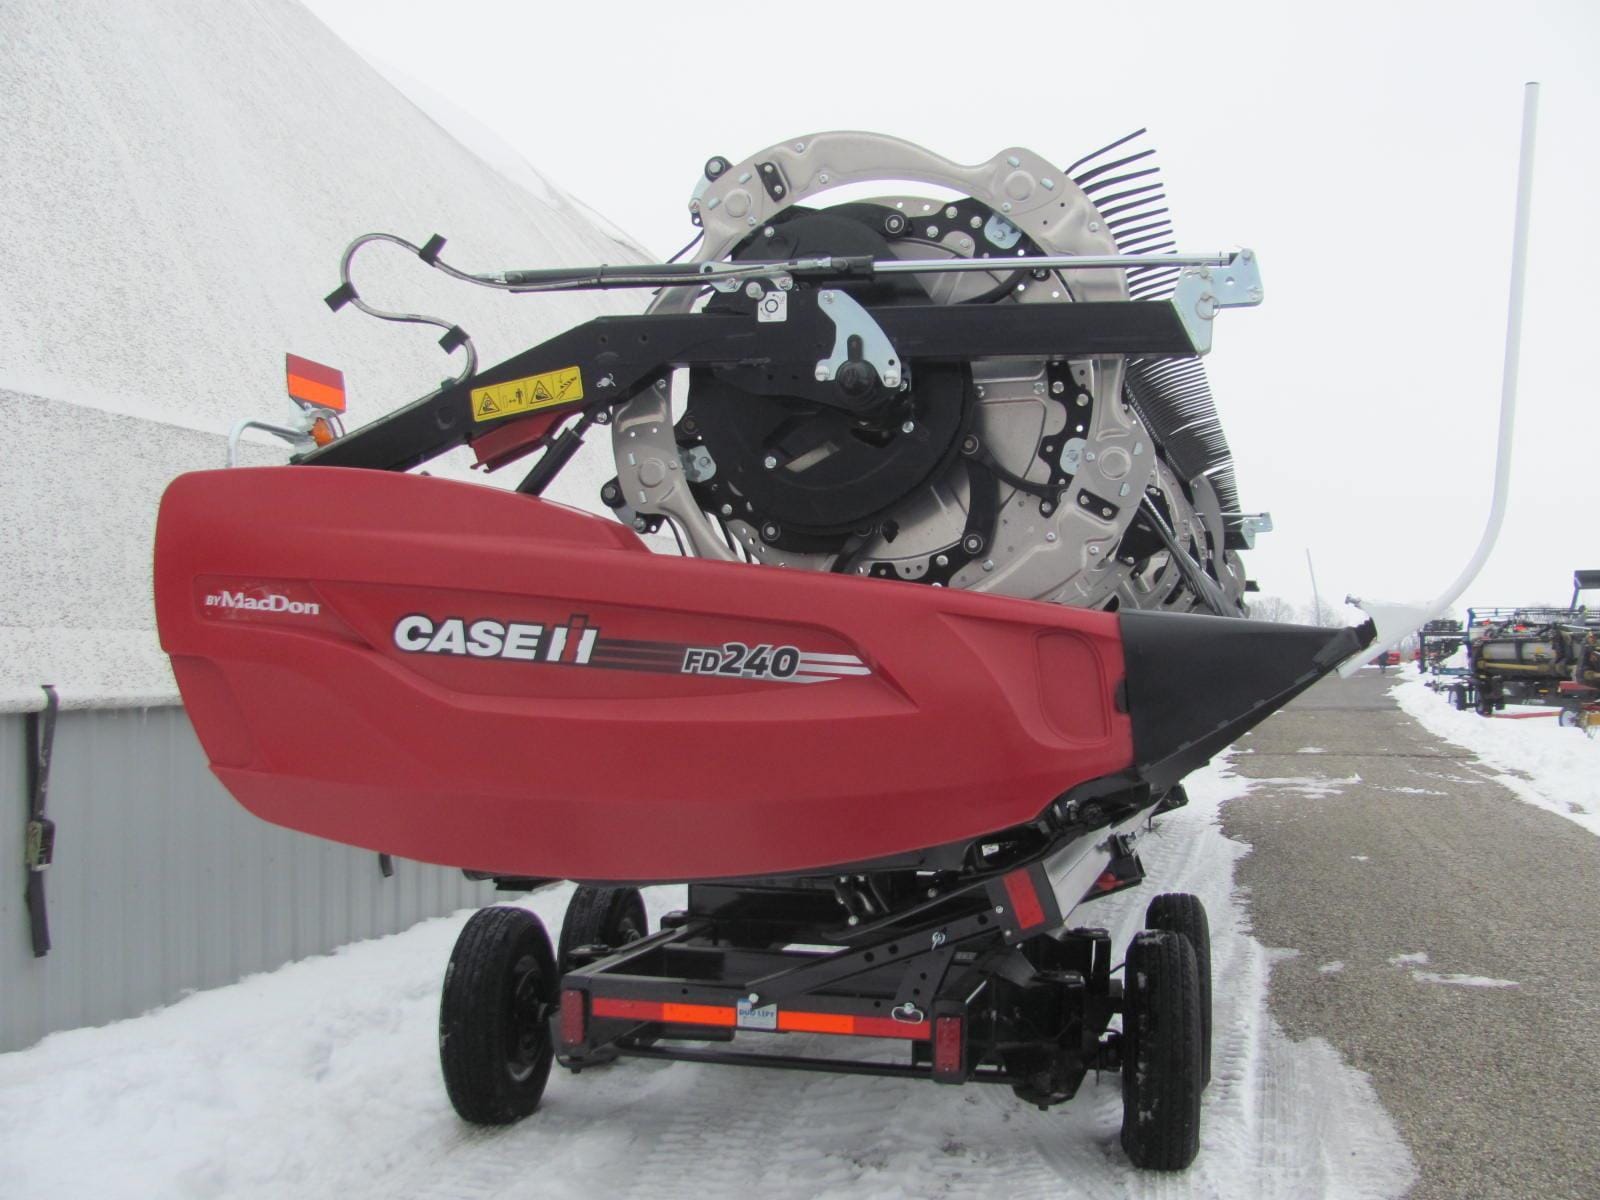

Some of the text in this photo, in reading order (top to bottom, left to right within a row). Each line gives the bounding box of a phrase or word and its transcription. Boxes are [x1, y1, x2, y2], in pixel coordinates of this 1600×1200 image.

[221, 591, 320, 615] MacDon
[394, 615, 544, 661] CASE
[682, 642, 801, 679] FD240
